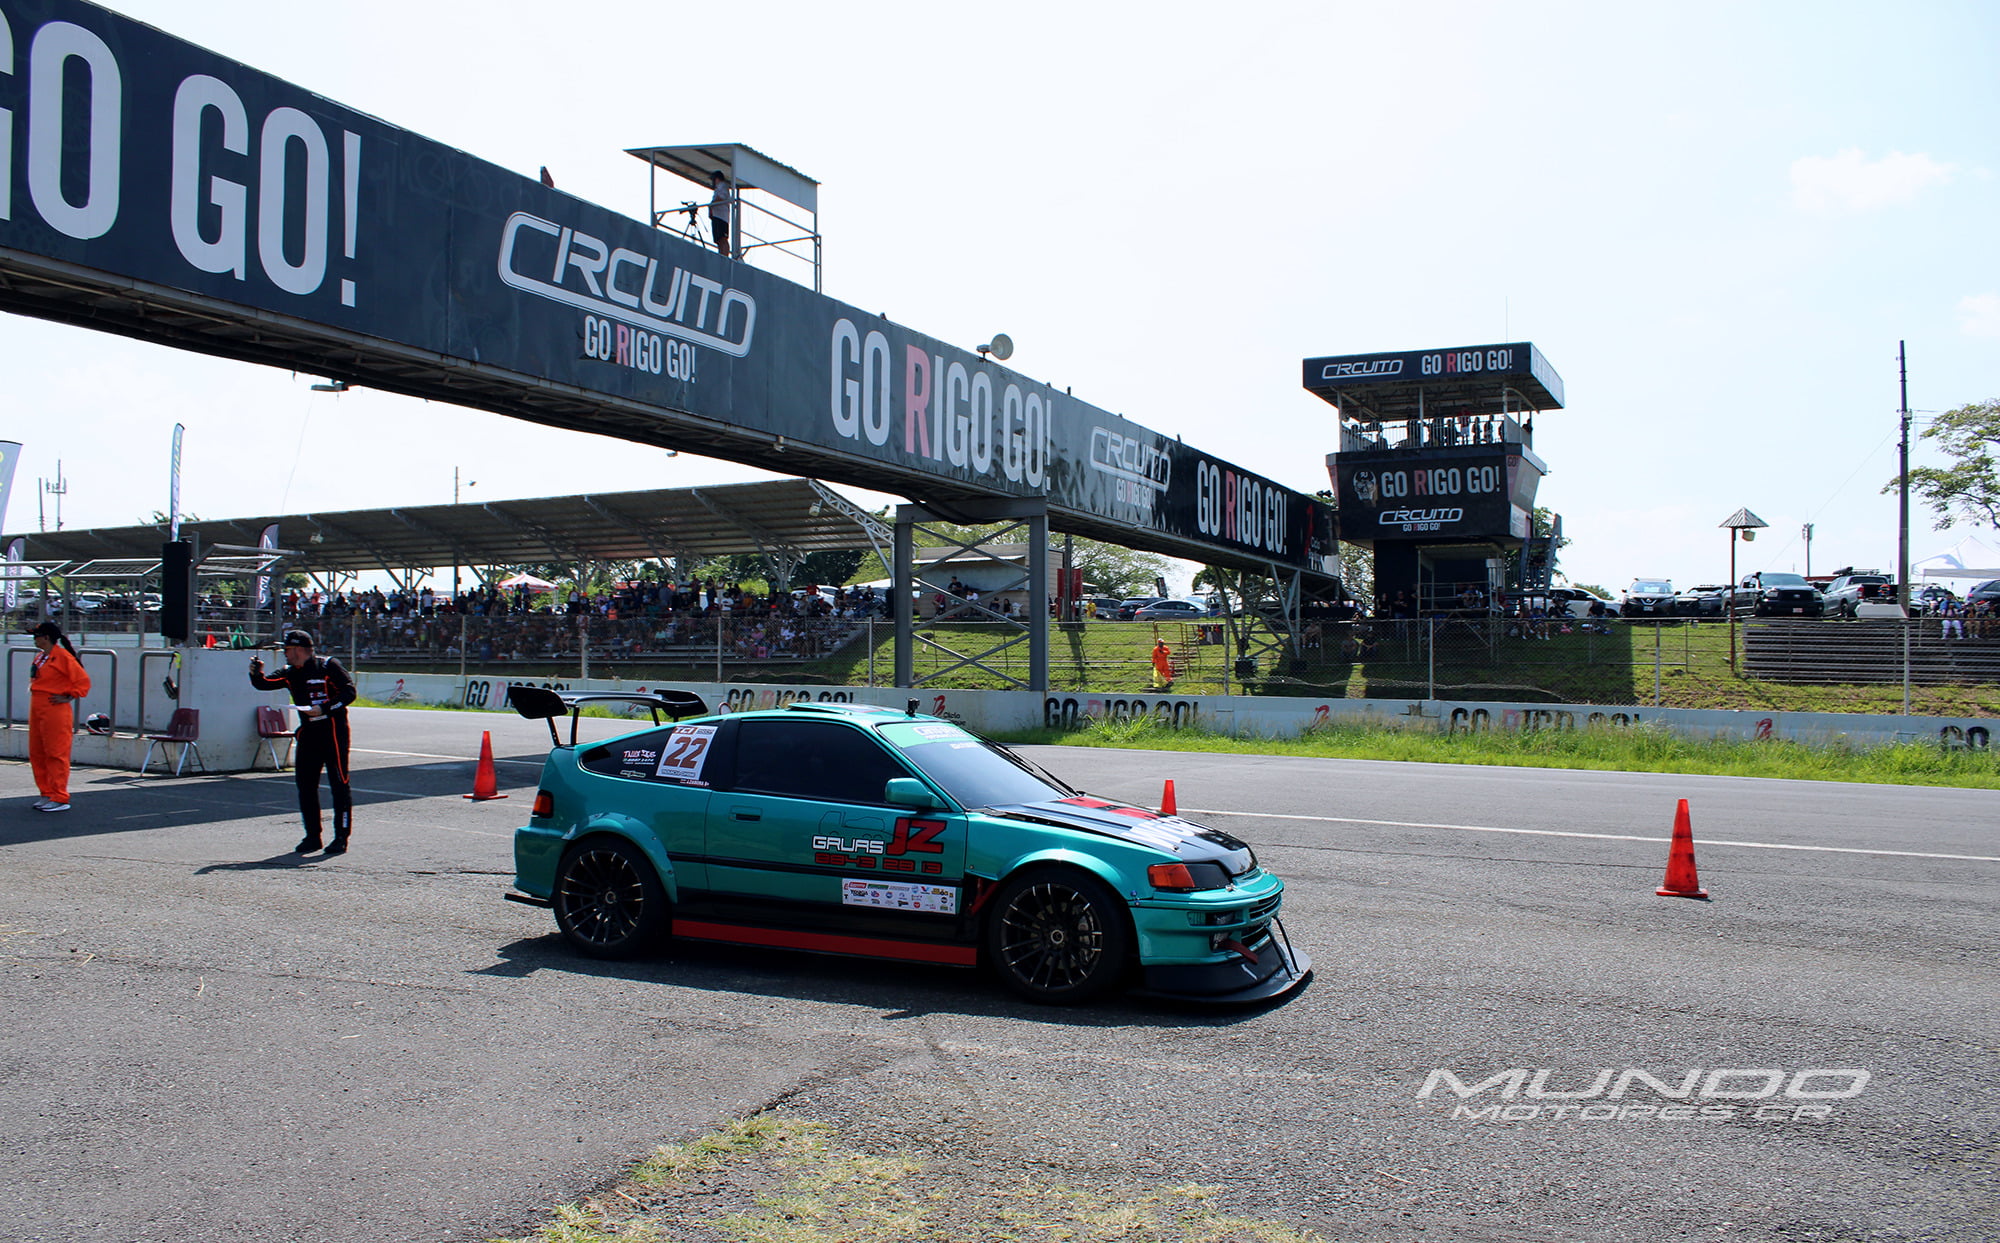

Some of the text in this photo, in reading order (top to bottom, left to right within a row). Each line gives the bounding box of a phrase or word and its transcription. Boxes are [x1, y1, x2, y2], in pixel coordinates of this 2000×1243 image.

[170, 74, 361, 307] GO!
[498, 211, 756, 358] CIRCUITO
[584, 315, 696, 384] GO RIGO GO!
[1321, 349, 1513, 380] CIRCUITO GO RIGO GO!
[831, 318, 1052, 491] GO RIGO GO!
[1090, 426, 1172, 493] CIRCUITO
[1381, 465, 1500, 498] GO RIGO GO!
[1197, 460, 1287, 555] GO RIGO GO!
[1379, 508, 1464, 525] CIRCUITO
[1403, 522, 1440, 532] GO RIGO GO!
[465, 680, 490, 708] GO
[1044, 697, 1080, 731] GO
[663, 736, 708, 769] 22
[813, 817, 947, 856] GRUAS JZ
